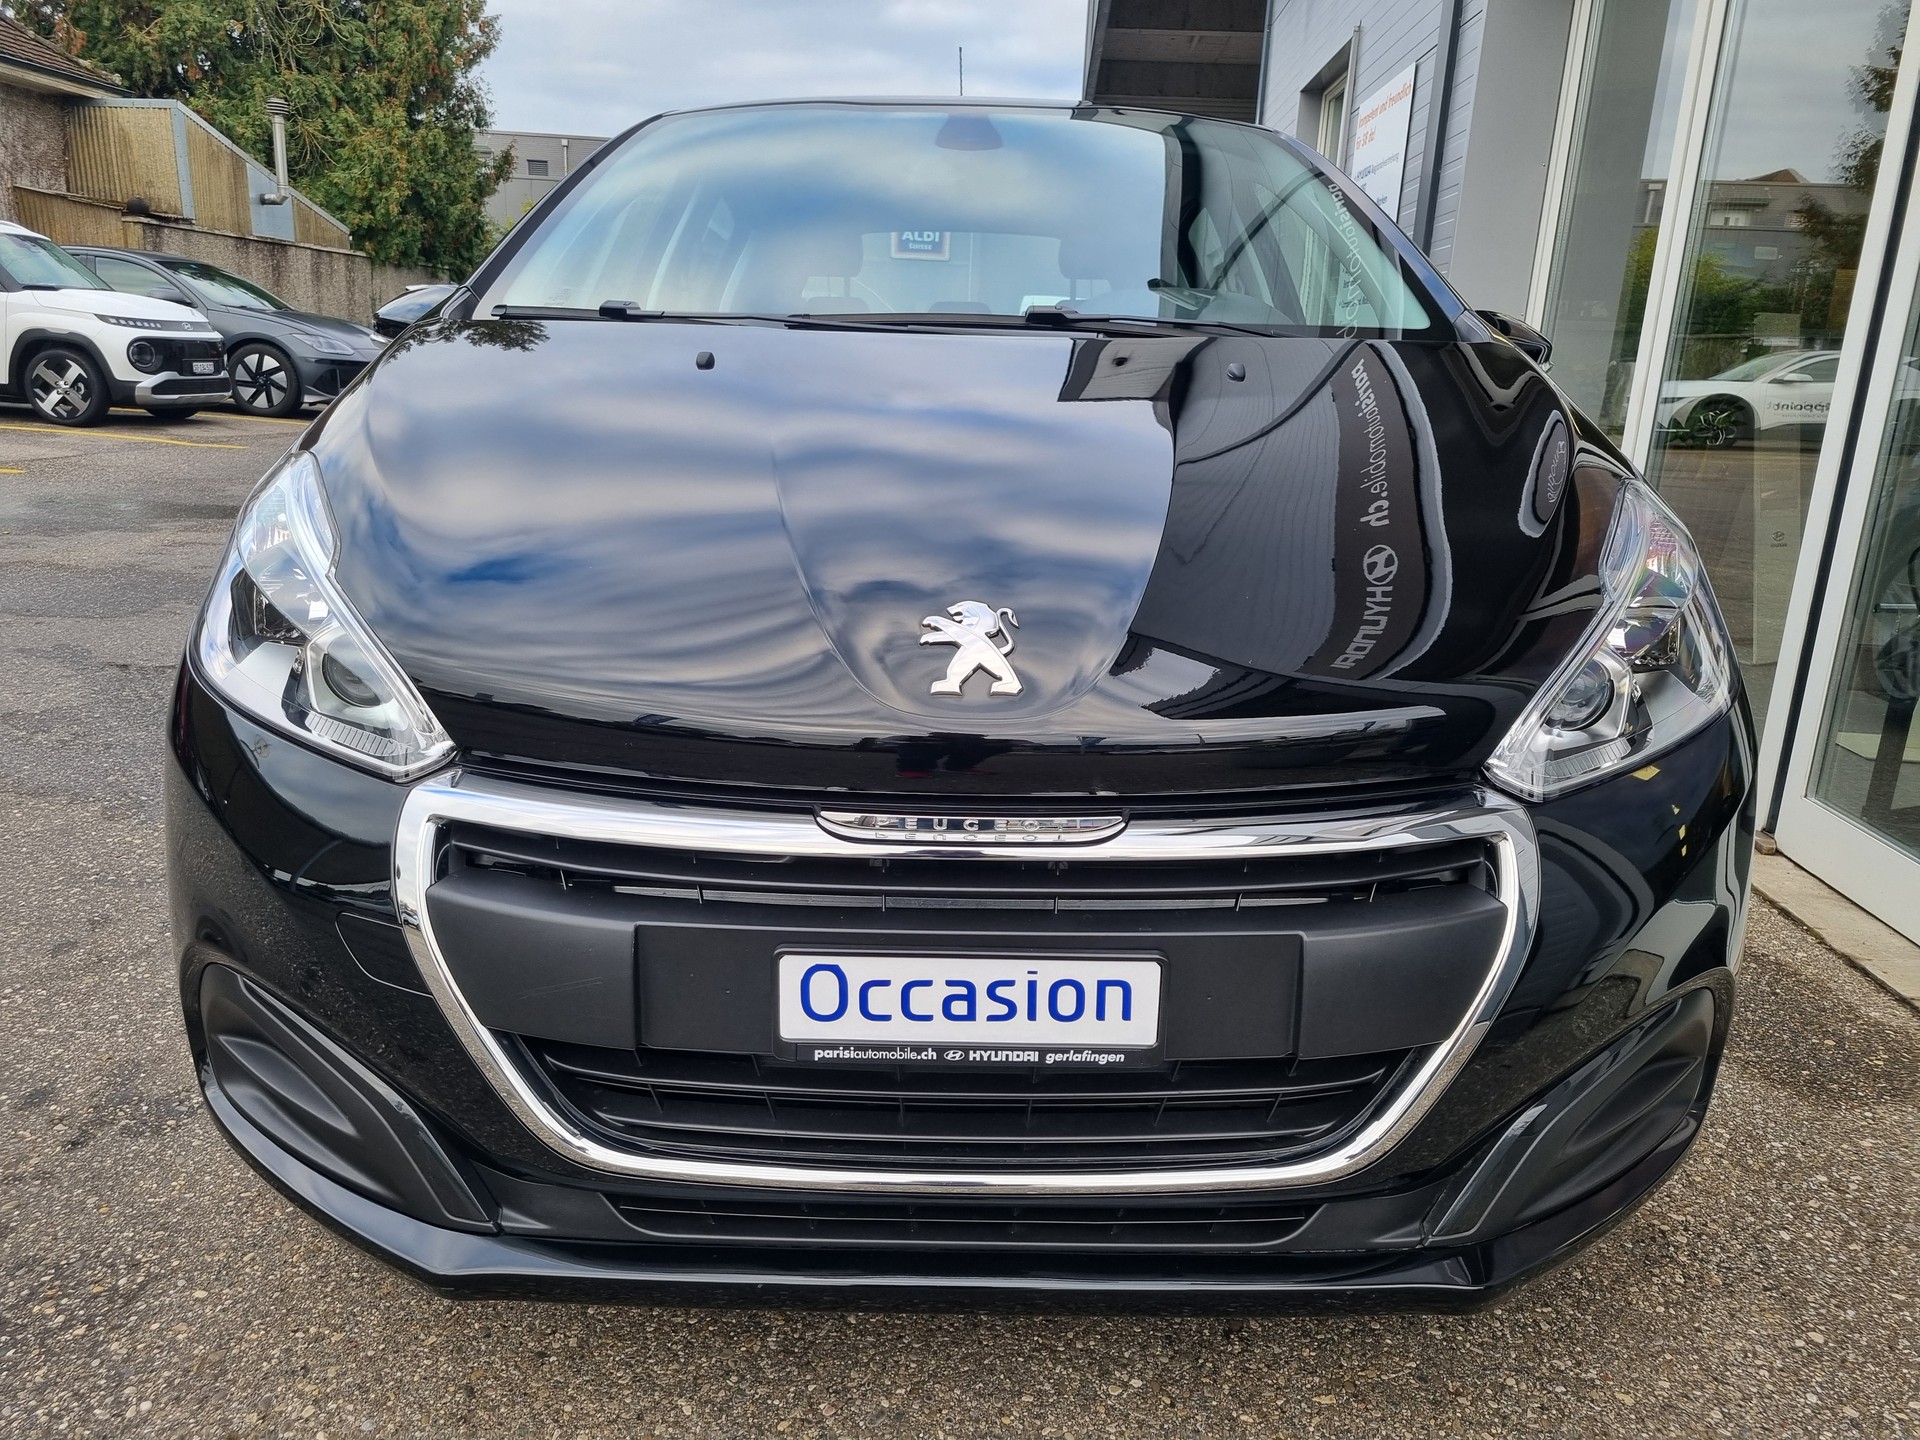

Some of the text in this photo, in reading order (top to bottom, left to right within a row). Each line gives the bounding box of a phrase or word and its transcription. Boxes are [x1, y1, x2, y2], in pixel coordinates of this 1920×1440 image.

[902, 231, 940, 242] ALDI
[875, 816, 1067, 831] PEUGEOT
[800, 963, 1132, 1022] Occasion
[814, 1047, 1125, 1064] parisiautomobile.ch HYUNDAI gerlafingen
